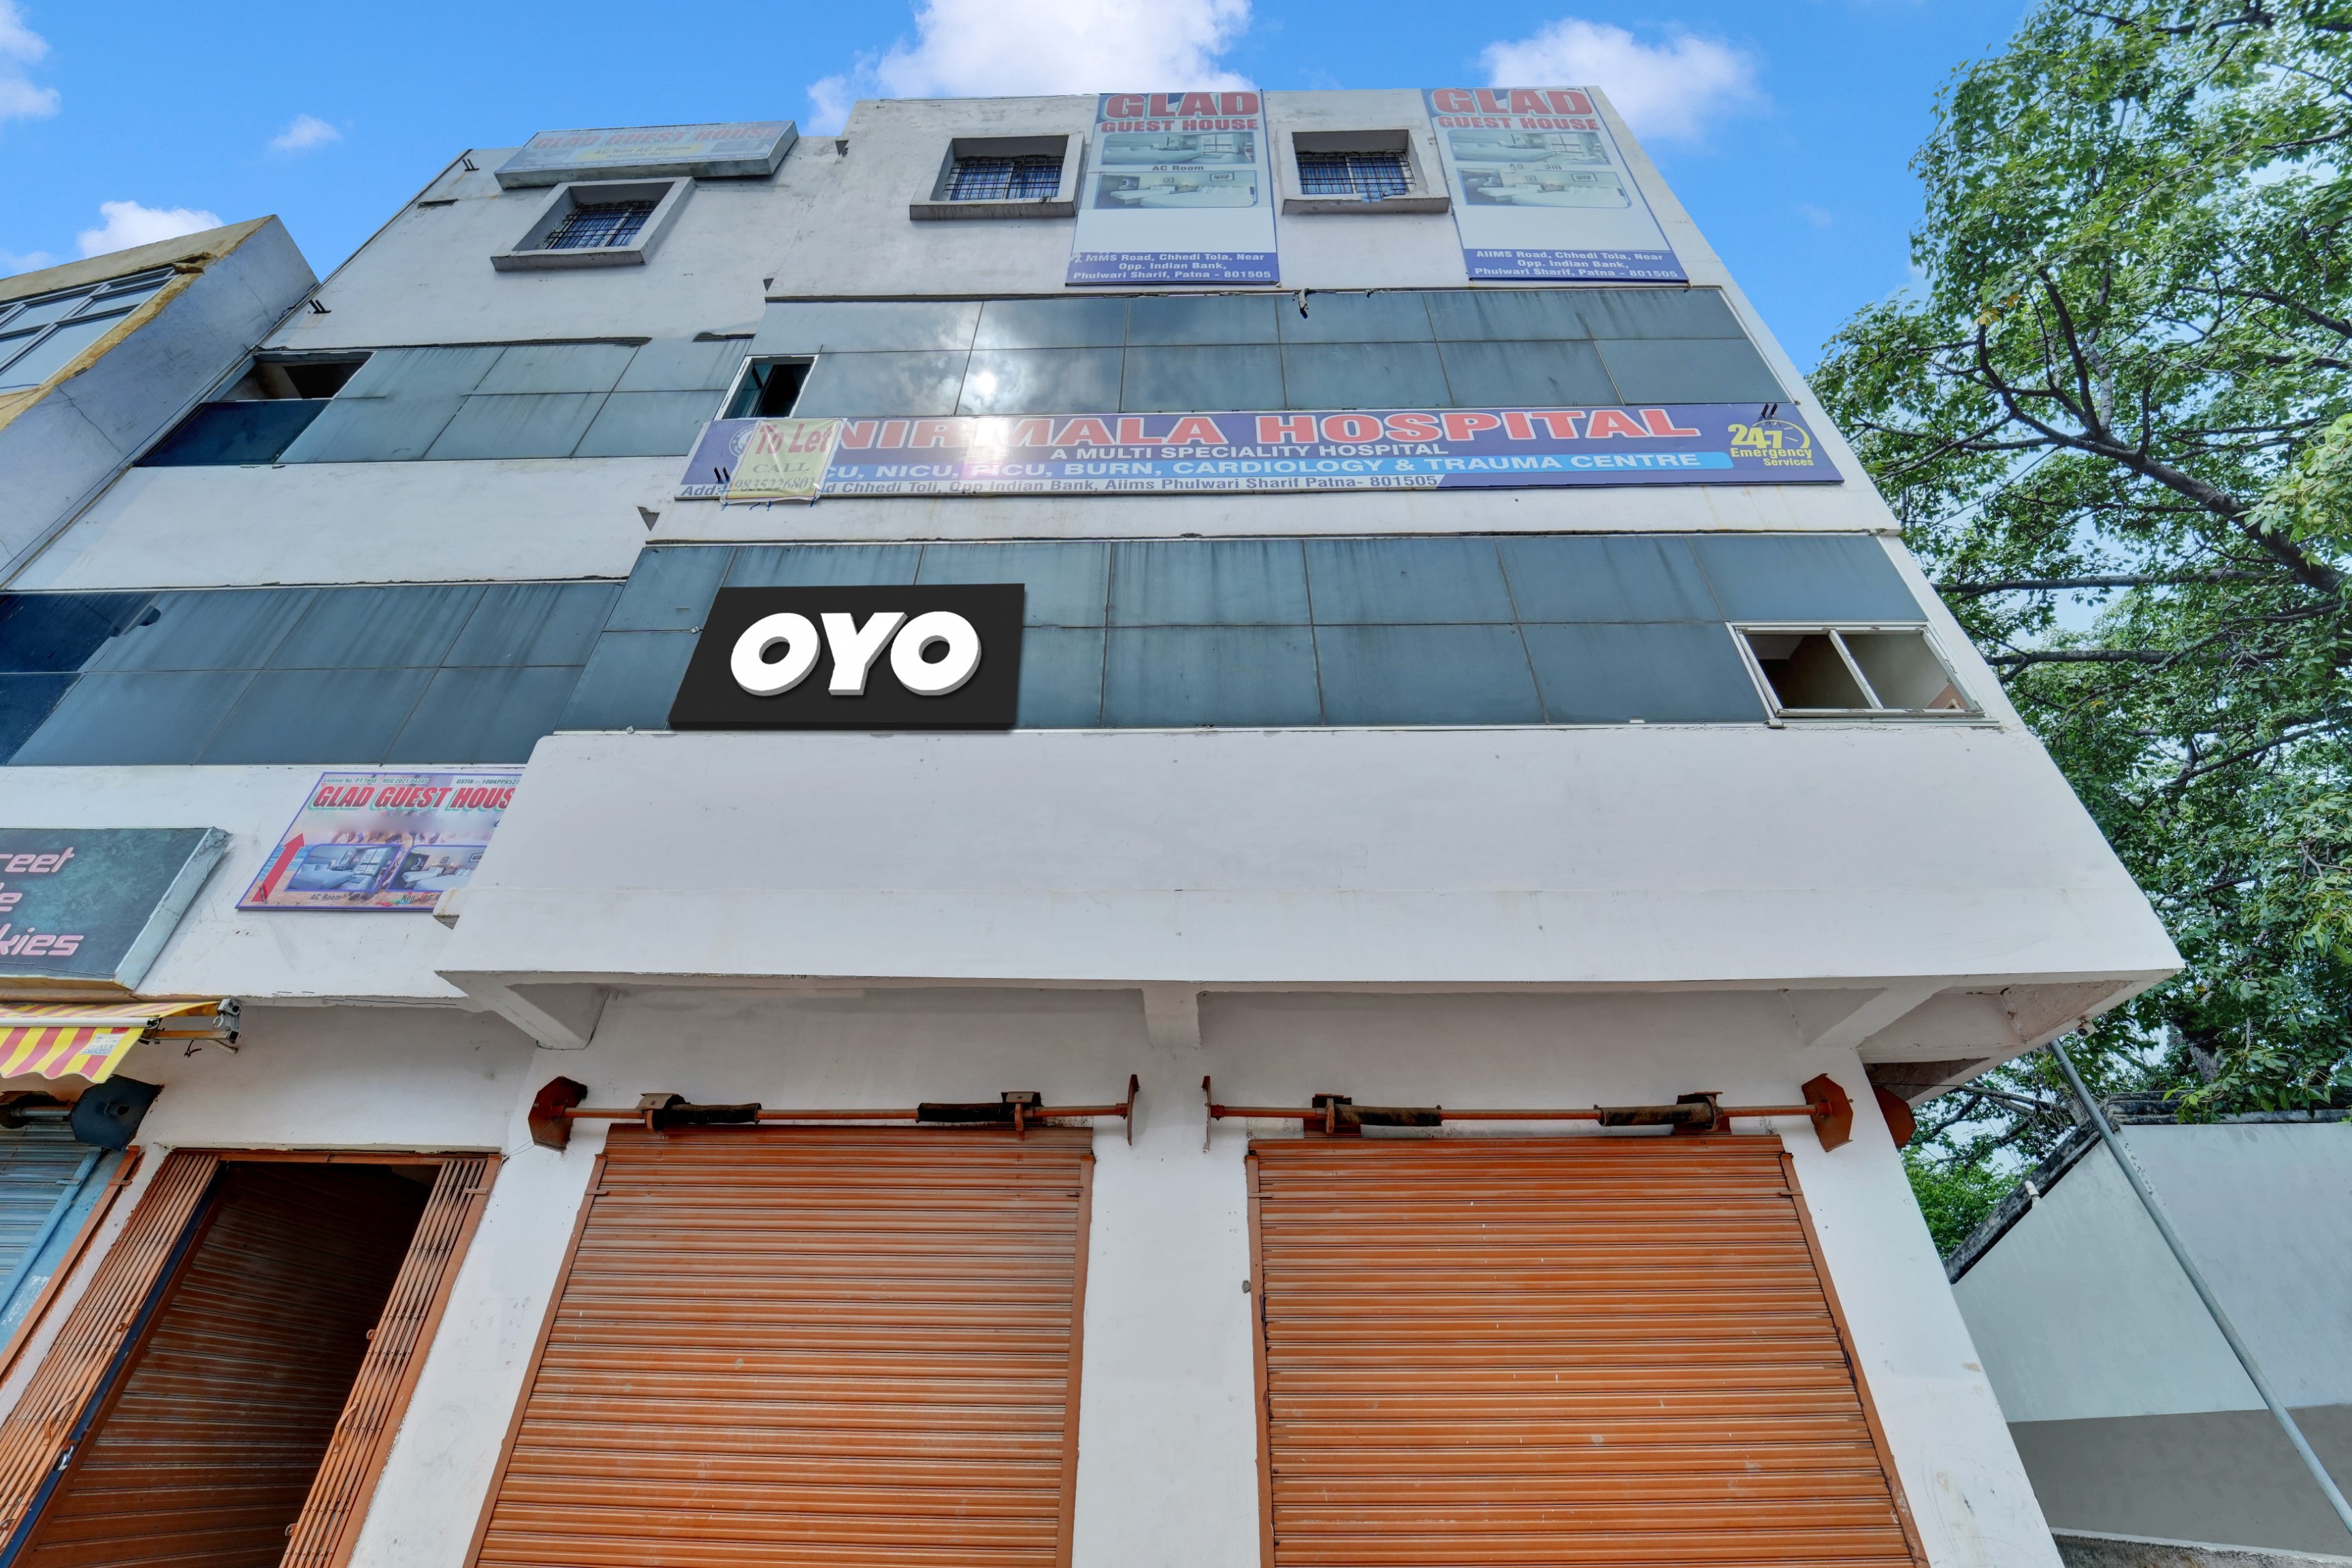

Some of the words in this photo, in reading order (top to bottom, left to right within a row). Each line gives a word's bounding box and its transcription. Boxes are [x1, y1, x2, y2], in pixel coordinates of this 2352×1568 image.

[1104, 92, 1260, 118] GLAD
[1432, 89, 1593, 116] GLAD
[1101, 120, 1175, 132] GUEST
[1182, 119, 1258, 131] HOUSE
[1438, 116, 1512, 129] GUEST
[1520, 117, 1601, 130] HOUSE
[1121, 253, 1155, 261] Road,
[1204, 253, 1232, 261] Tola,
[1516, 251, 1552, 259] Road,
[1555, 252, 1598, 260] Chhedi
[1601, 252, 1631, 261] Tola,
[1192, 262, 1226, 270] Bank,
[1517, 259, 1546, 267] Opp.
[1549, 260, 1589, 268] Indian
[1593, 261, 1629, 270] Bank,
[1130, 271, 1170, 279] Sharif,
[840, 416, 1229, 449] NIRMALA
[1256, 409, 1701, 444] HOSPITAL
[755, 425, 785, 454] To
[788, 424, 834, 453] Let
[1050, 448, 1068, 459] A
[1077, 447, 1152, 459] MULTI
[1161, 444, 1311, 459] SPECIALITY
[1319, 443, 1449, 457] HOSPITAL
[1730, 448, 1812, 459] Emergency
[753, 462, 811, 474] CALL
[875, 465, 959, 479] NICU,
[1064, 461, 1162, 476] BURN,
[1173, 459, 1384, 475] CARDIOLOGY
[1394, 459, 1416, 471] &
[1424, 457, 1563, 470] TRAUMA
[1570, 454, 1701, 468] CENTRE
[842, 482, 902, 493] Chhedi
[909, 482, 941, 495] Toli,
[949, 480, 983, 494] Opp
[990, 480, 1043, 491] Indian
[1050, 479, 1098, 492] Bank,
[1105, 479, 1155, 490] Aiims
[1162, 478, 1239, 489] Phulwari
[1246, 477, 1299, 489] Sharif
[1370, 476, 1438, 487] 801505
[730, 611, 982, 696] OYO
[312, 786, 374, 808] GLAD
[374, 787, 453, 808] GUEST
